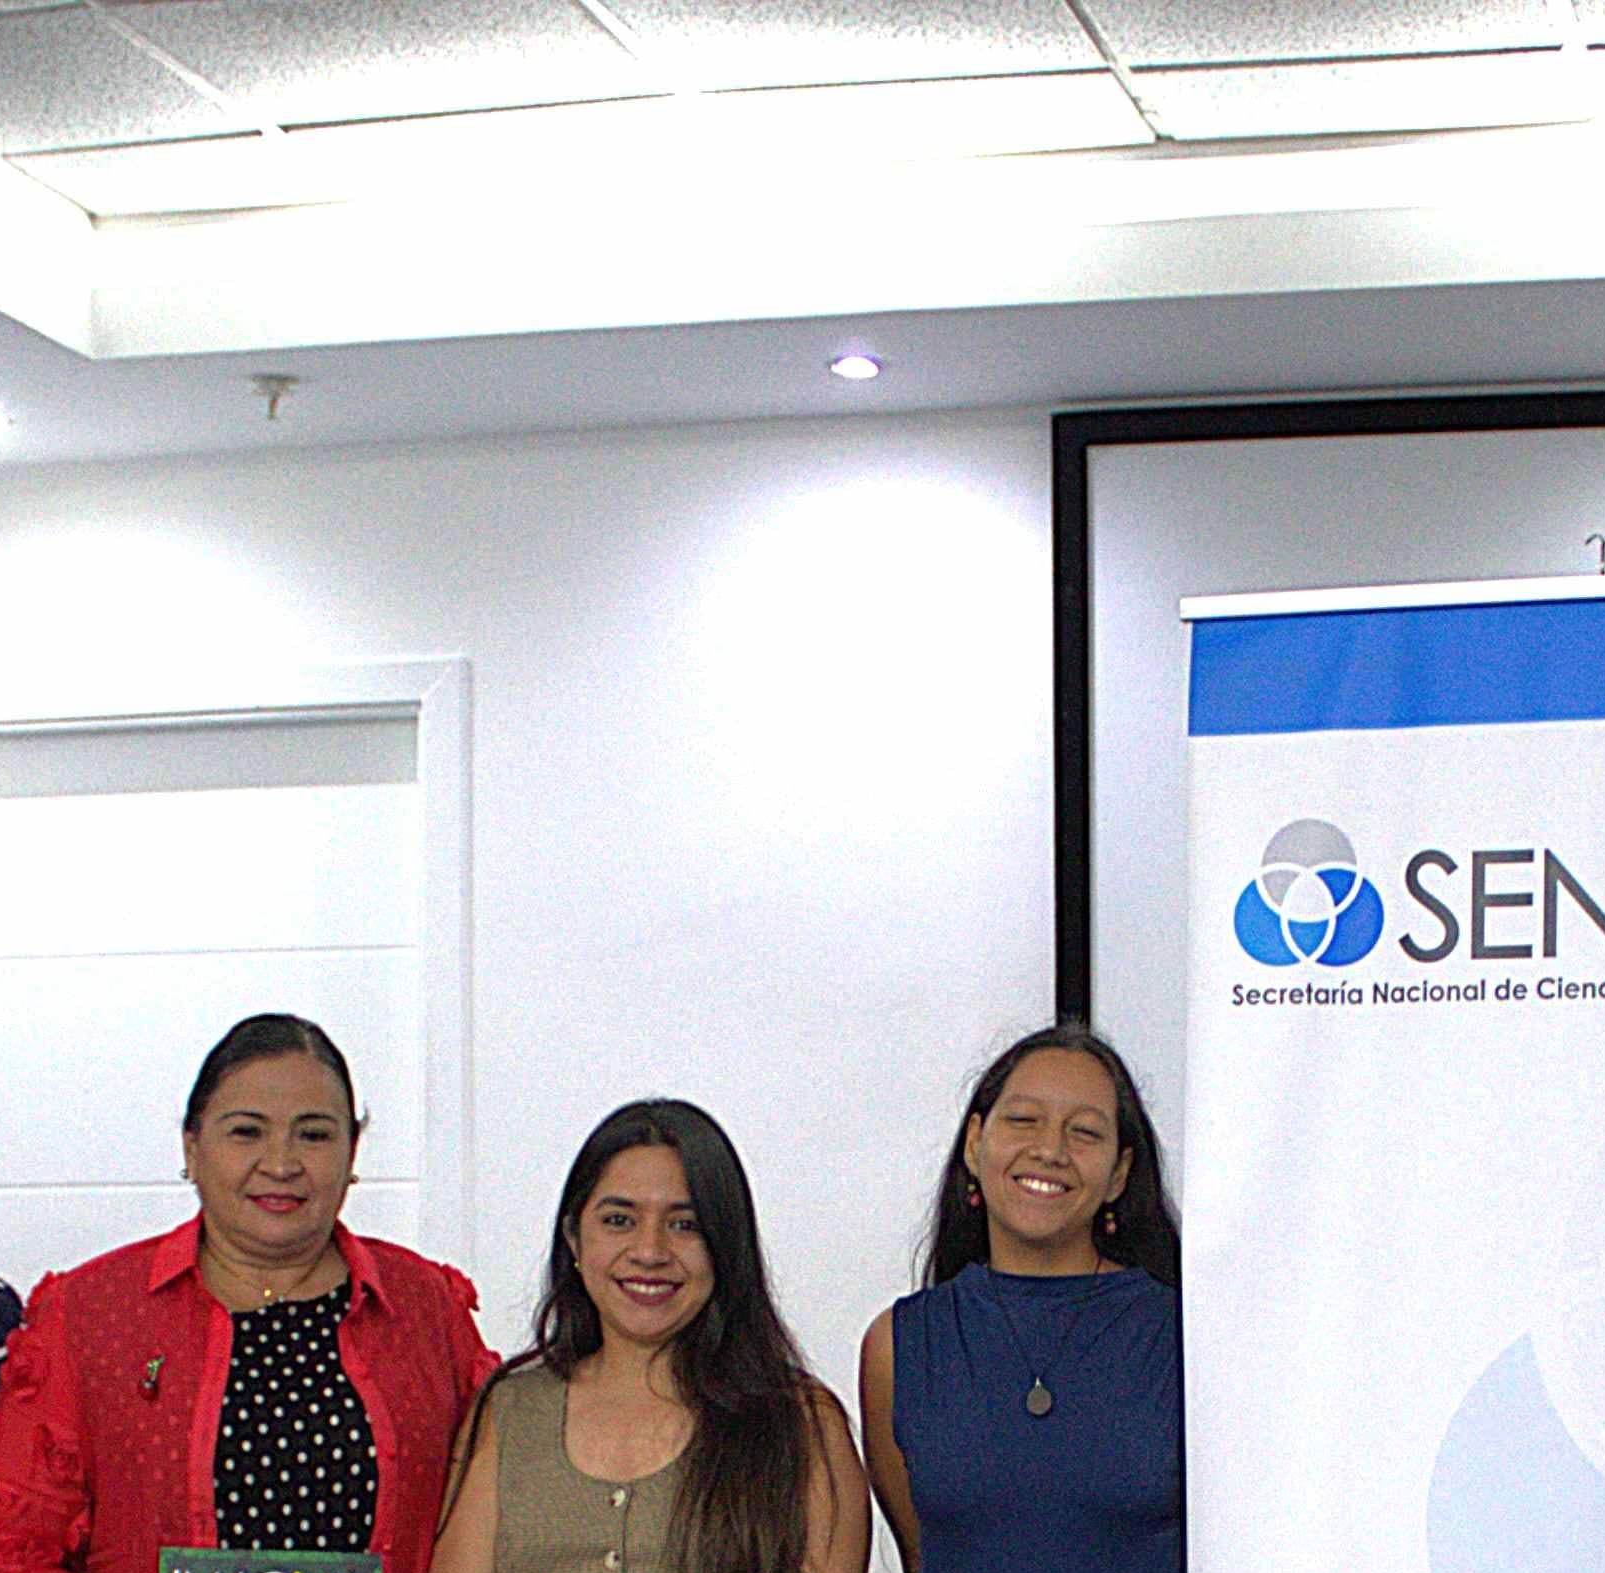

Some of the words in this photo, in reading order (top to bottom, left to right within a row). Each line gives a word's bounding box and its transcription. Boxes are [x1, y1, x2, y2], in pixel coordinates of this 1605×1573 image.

[1232, 981, 1363, 1006] Secretaría
[1372, 979, 1486, 1004] Nacional
[1494, 979, 1528, 1000] de
